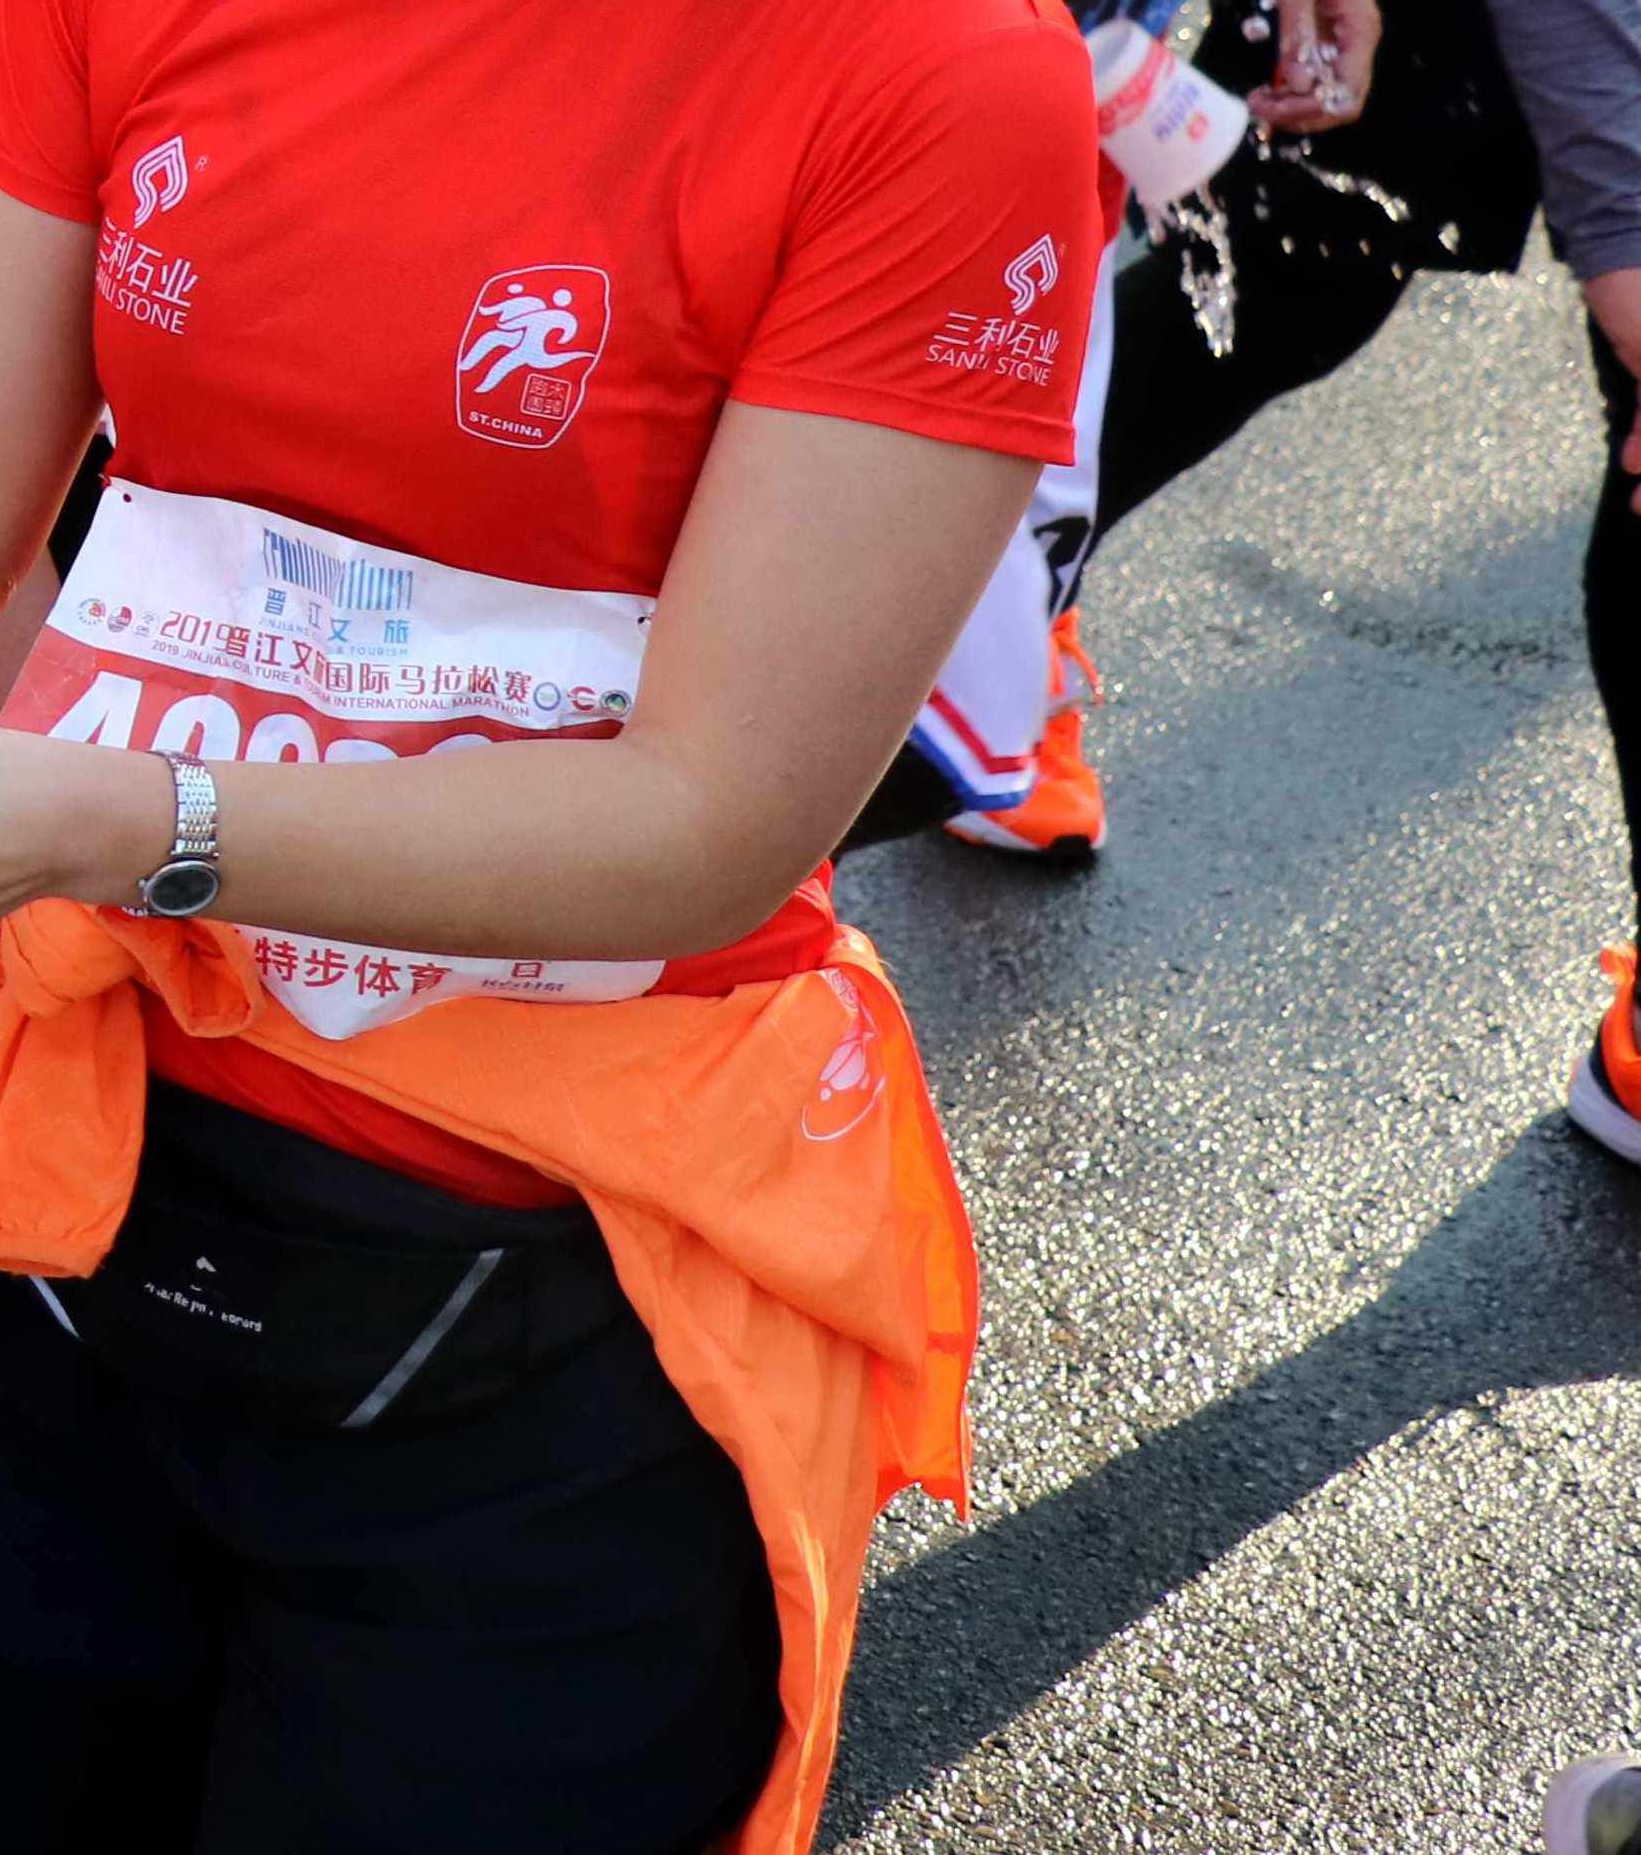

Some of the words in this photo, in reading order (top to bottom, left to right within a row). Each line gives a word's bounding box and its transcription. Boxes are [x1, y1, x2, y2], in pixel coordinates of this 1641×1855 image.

[116, 288, 188, 336] STONE
[933, 311, 1060, 366] 三利石业
[995, 356, 1052, 387] STONE
[469, 409, 544, 439] ST.CHINA
[151, 639, 180, 656] 2019
[332, 694, 447, 711] INTERNATIONAL
[452, 696, 530, 718] MARATHON
[160, 610, 533, 705] 2019晋江文国际马拉松赛
[255, 936, 453, 998] 特步体育
